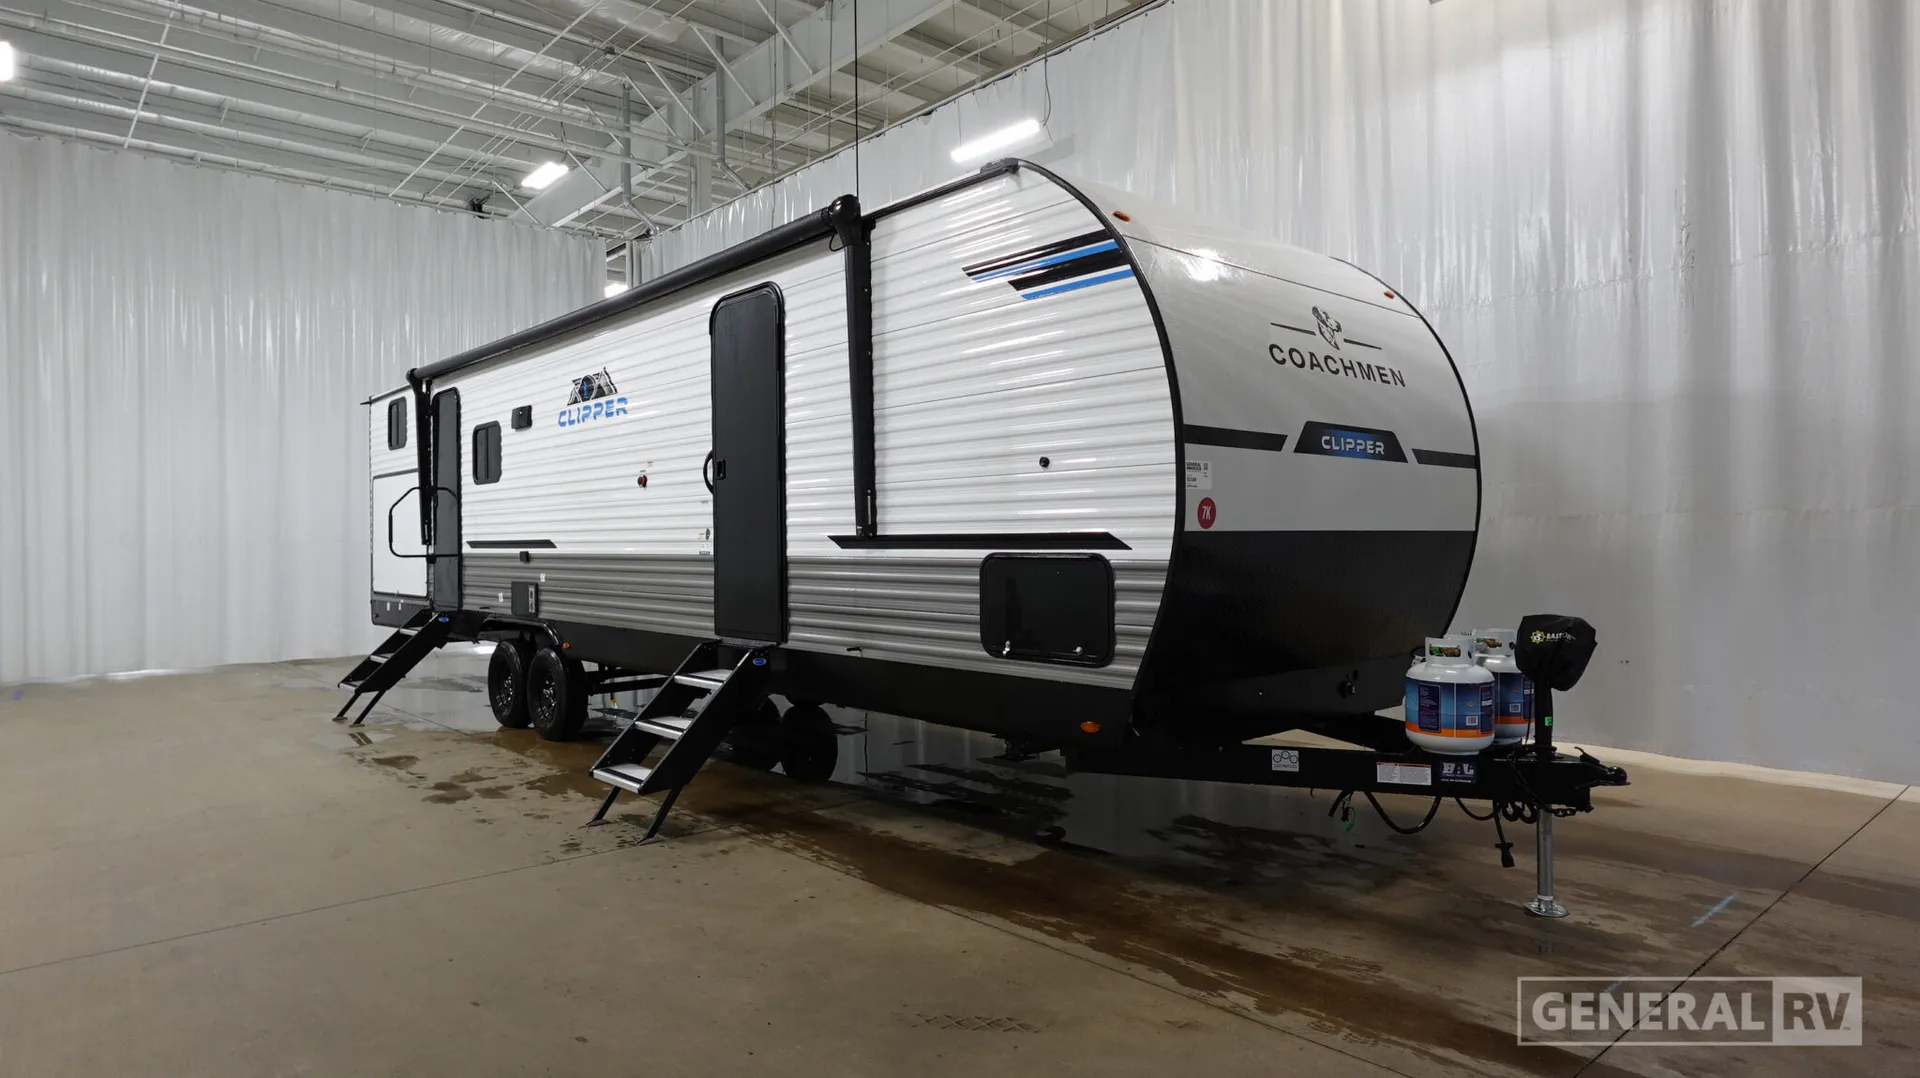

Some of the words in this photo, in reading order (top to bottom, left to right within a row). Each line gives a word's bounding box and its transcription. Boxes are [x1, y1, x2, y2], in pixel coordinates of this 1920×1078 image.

[1268, 343, 1406, 387] COACHMEN
[557, 397, 628, 427] CLIPPER
[1321, 435, 1385, 456] CLIPPER
